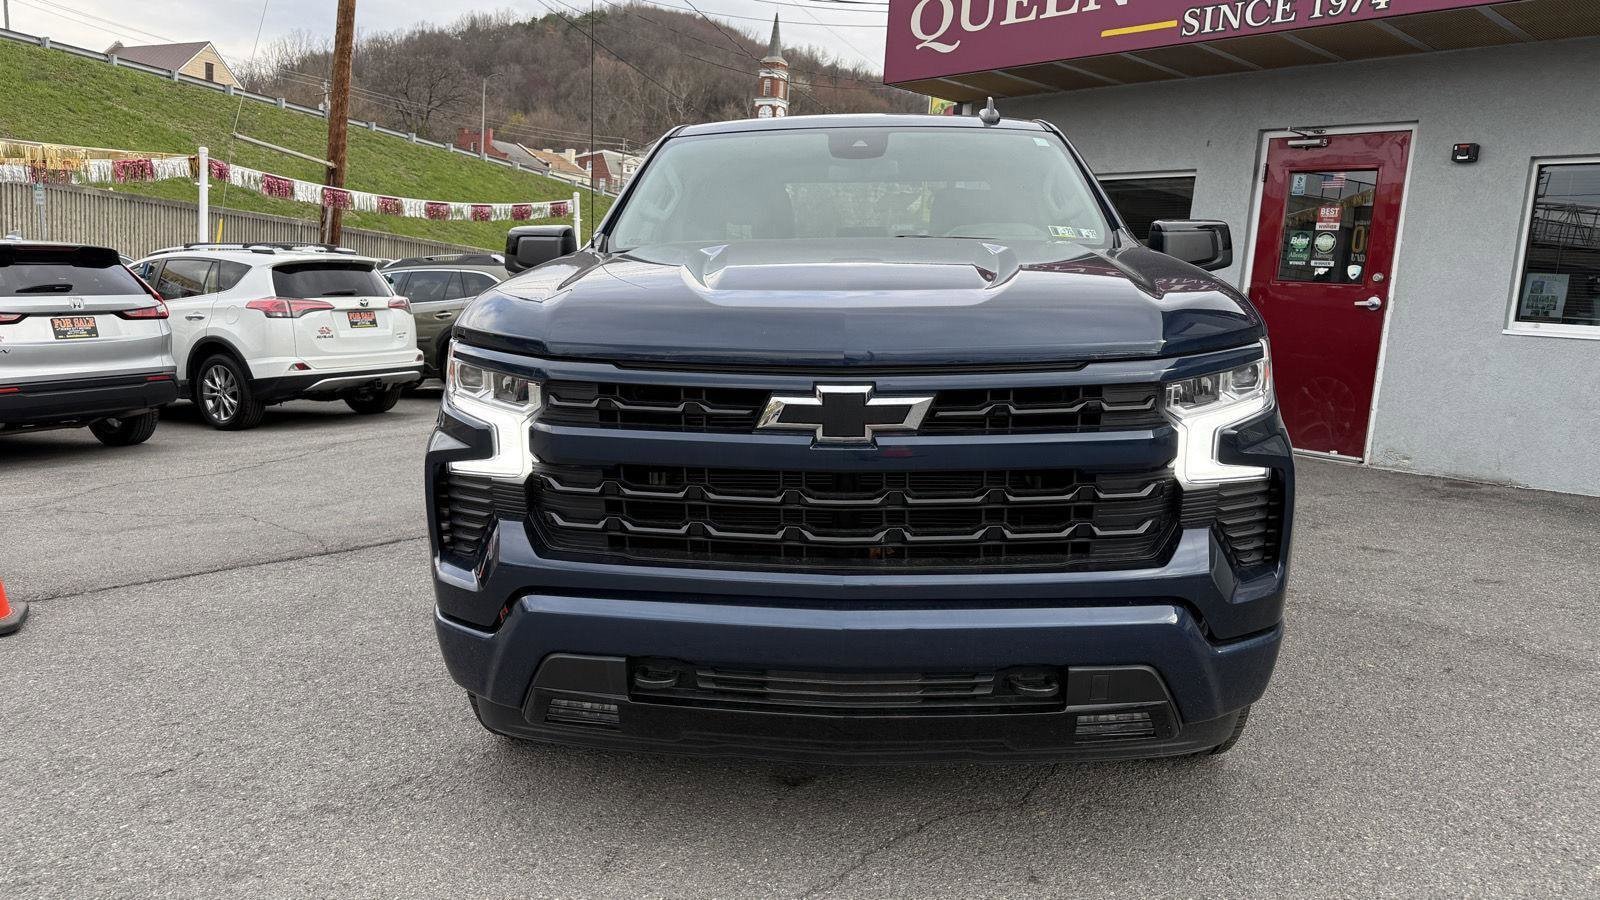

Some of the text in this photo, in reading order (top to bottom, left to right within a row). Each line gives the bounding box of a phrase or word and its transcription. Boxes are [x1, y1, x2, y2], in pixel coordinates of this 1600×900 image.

[910, 0, 1128, 53] QUE
[1181, 0, 1297, 37] SINCE
[1321, 207, 1340, 215] BEST
[53, 317, 95, 328] FOR SALE
